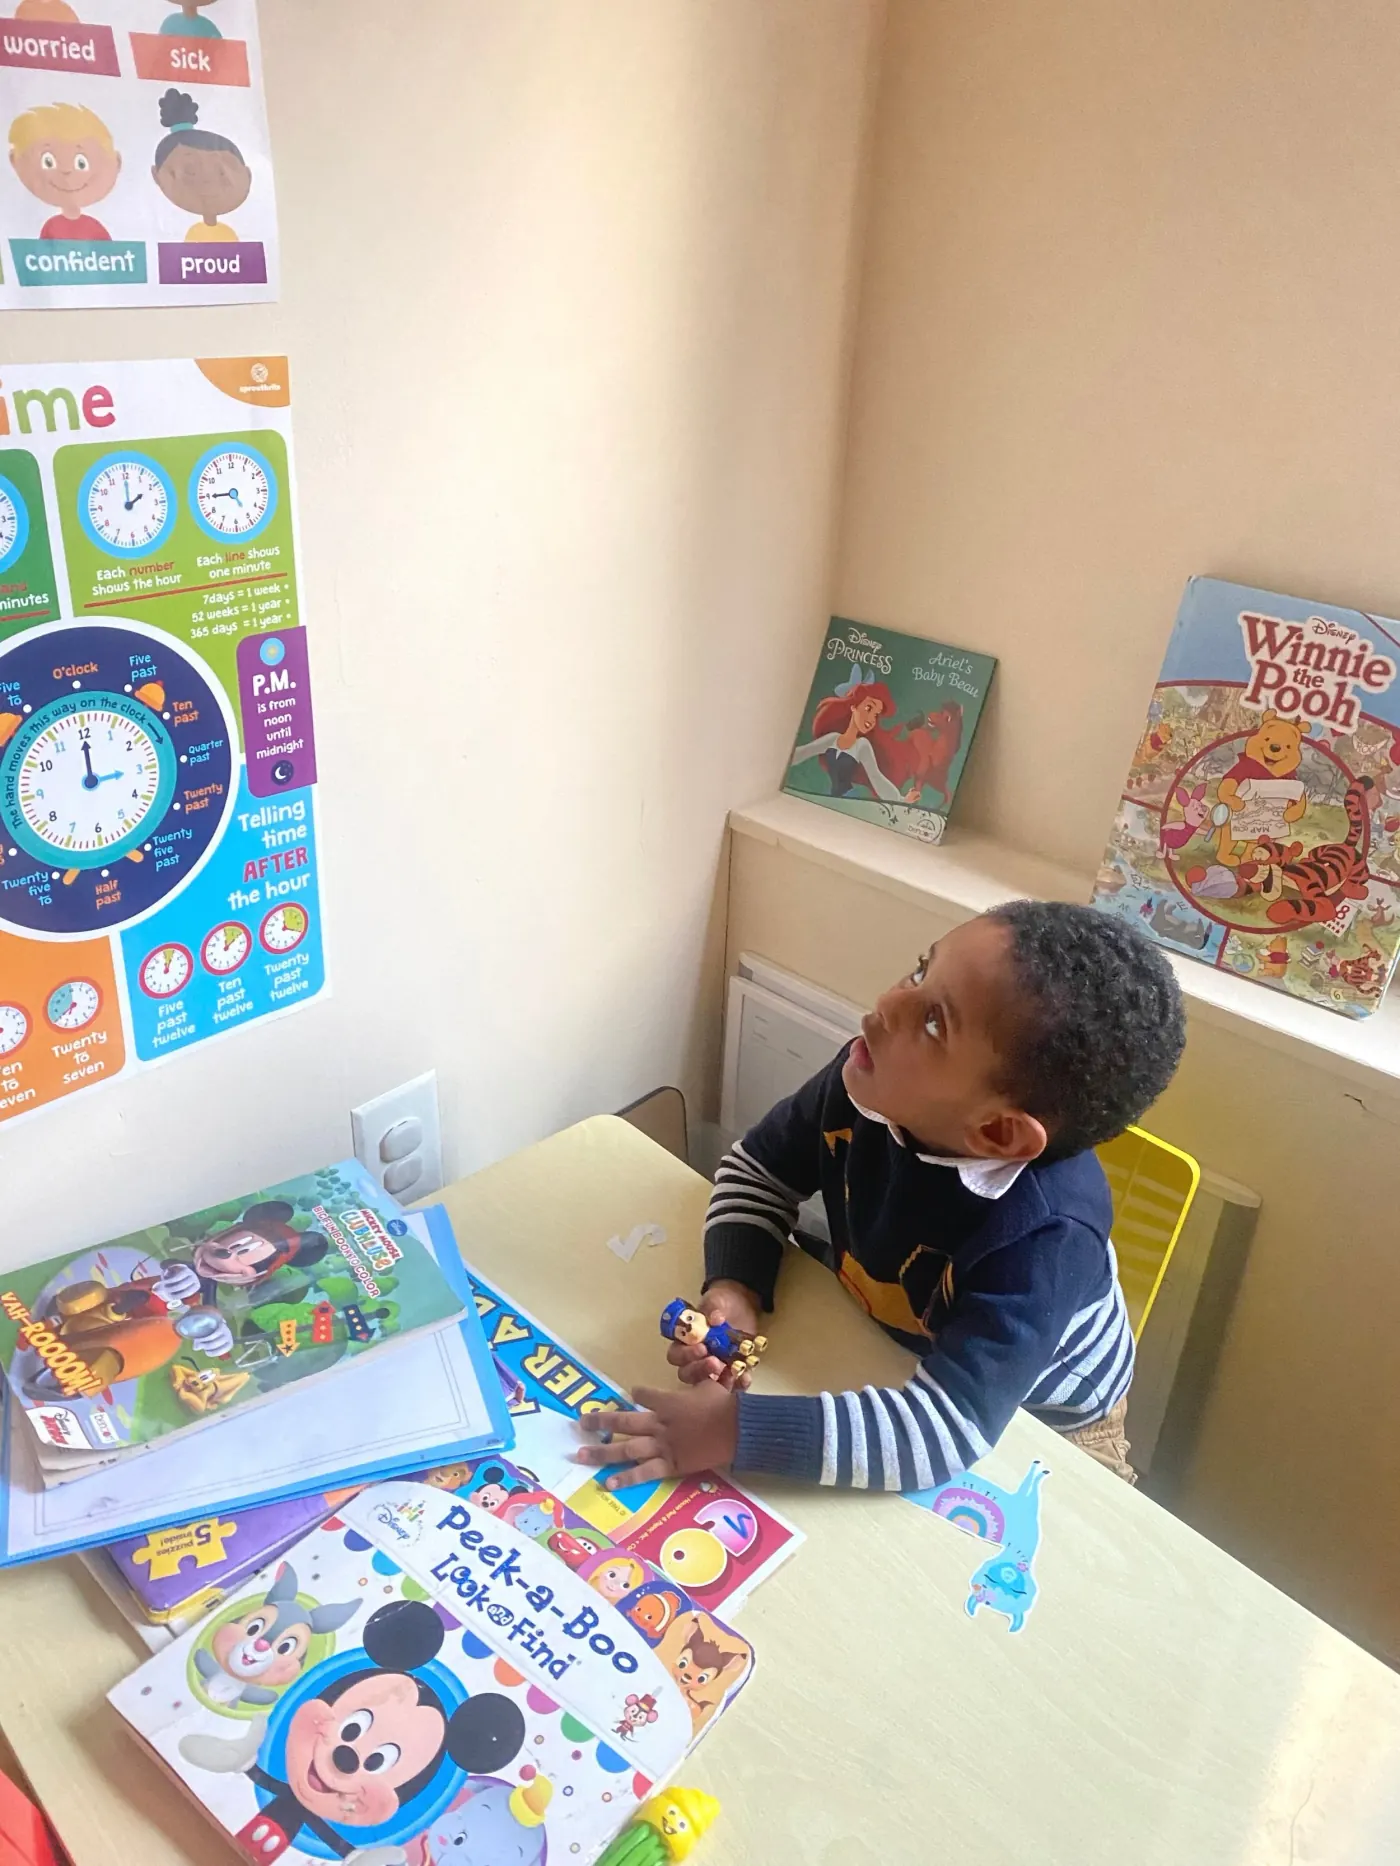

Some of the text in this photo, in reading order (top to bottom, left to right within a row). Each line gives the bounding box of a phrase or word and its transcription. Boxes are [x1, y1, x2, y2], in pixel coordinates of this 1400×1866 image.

[4, 37, 97, 62] worried
[169, 47, 212, 73] sick
[25, 249, 136, 273] confident
[180, 254, 241, 279] proud
[197, 546, 281, 567] Each line shows
[96, 561, 175, 581] Each number
[209, 560, 271, 579] one minute
[92, 573, 182, 596] shows the hour
[252, 584, 281, 598] week
[191, 611, 204, 623] 52
[207, 606, 240, 620] weeks
[258, 598, 282, 615] year
[190, 625, 209, 639] 365
[212, 622, 238, 638] days
[259, 613, 283, 630] year
[1311, 617, 1357, 645] Disney
[848, 627, 884, 653] Disney
[129, 653, 152, 667] Five
[827, 638, 893, 675] PRINCESS
[1242, 615, 1391, 688] Winnie
[52, 661, 99, 680] O'clock
[131, 664, 158, 682] past
[928, 652, 974, 676] Ariel's
[252, 669, 297, 697] P.M.
[912, 667, 980, 698] Baby Beau
[1292, 667, 1325, 688] the
[7, 694, 23, 707] to
[1244, 659, 1357, 728] Pooh
[172, 700, 193, 712] Ten
[257, 696, 296, 714] is from
[174, 710, 199, 727] past
[264, 713, 292, 728] noon
[78, 727, 92, 741] 12
[107, 729, 113, 742] 1
[266, 727, 292, 742] until
[54, 741, 66, 754] 11
[126, 740, 133, 752] 2
[188, 738, 224, 755] Quarter
[256, 738, 304, 760] midnight
[5, 696, 147, 829] The hand moves this way on the clock
[39, 760, 53, 772] 10
[190, 751, 210, 766] past
[136, 763, 144, 775] 3
[36, 788, 44, 800] 9
[131, 788, 139, 800] 4
[184, 782, 223, 801] Twenty
[117, 808, 125, 820] 5
[185, 797, 209, 814] past
[49, 810, 57, 822] 8
[238, 800, 306, 832] Telling
[69, 822, 76, 834] 7
[95, 822, 102, 834] 6
[152, 828, 192, 846] Twenty
[261, 825, 308, 850] time
[154, 844, 174, 857] five
[155, 853, 180, 871] past
[243, 846, 309, 882] AFTER
[1, 870, 49, 890] Twenty
[28, 883, 51, 896] five
[95, 879, 118, 895] Half
[38, 895, 52, 906] to
[95, 891, 121, 909] past
[228, 872, 311, 911] the hour
[1336, 905, 1350, 920] 8
[263, 951, 310, 975] Twenty
[218, 976, 242, 993] Ten
[273, 967, 303, 989] past
[216, 987, 246, 1011] past
[269, 979, 309, 1002] twelve
[158, 999, 184, 1018] Five
[212, 1000, 254, 1025] twelve
[156, 1011, 188, 1034] past
[51, 1030, 107, 1058] Twenty
[152, 1024, 197, 1048] twelve
[73, 1051, 90, 1065] to
[0, 1060, 23, 1076] en
[63, 1060, 105, 1084] seven
[1, 1077, 19, 1092] to
[361, 1210, 400, 1259] MICKEY MOUSE
[323, 1217, 337, 1232] FUN
[332, 1230, 353, 1256] BOOK
[348, 1254, 360, 1266] TO
[355, 1265, 379, 1298] COLOR
[156, 1523, 212, 1557] 5 puzzles
[436, 1505, 639, 1674] Peek-a-Boo
[430, 1552, 490, 1612] Look
[507, 1617, 577, 1681] Find
